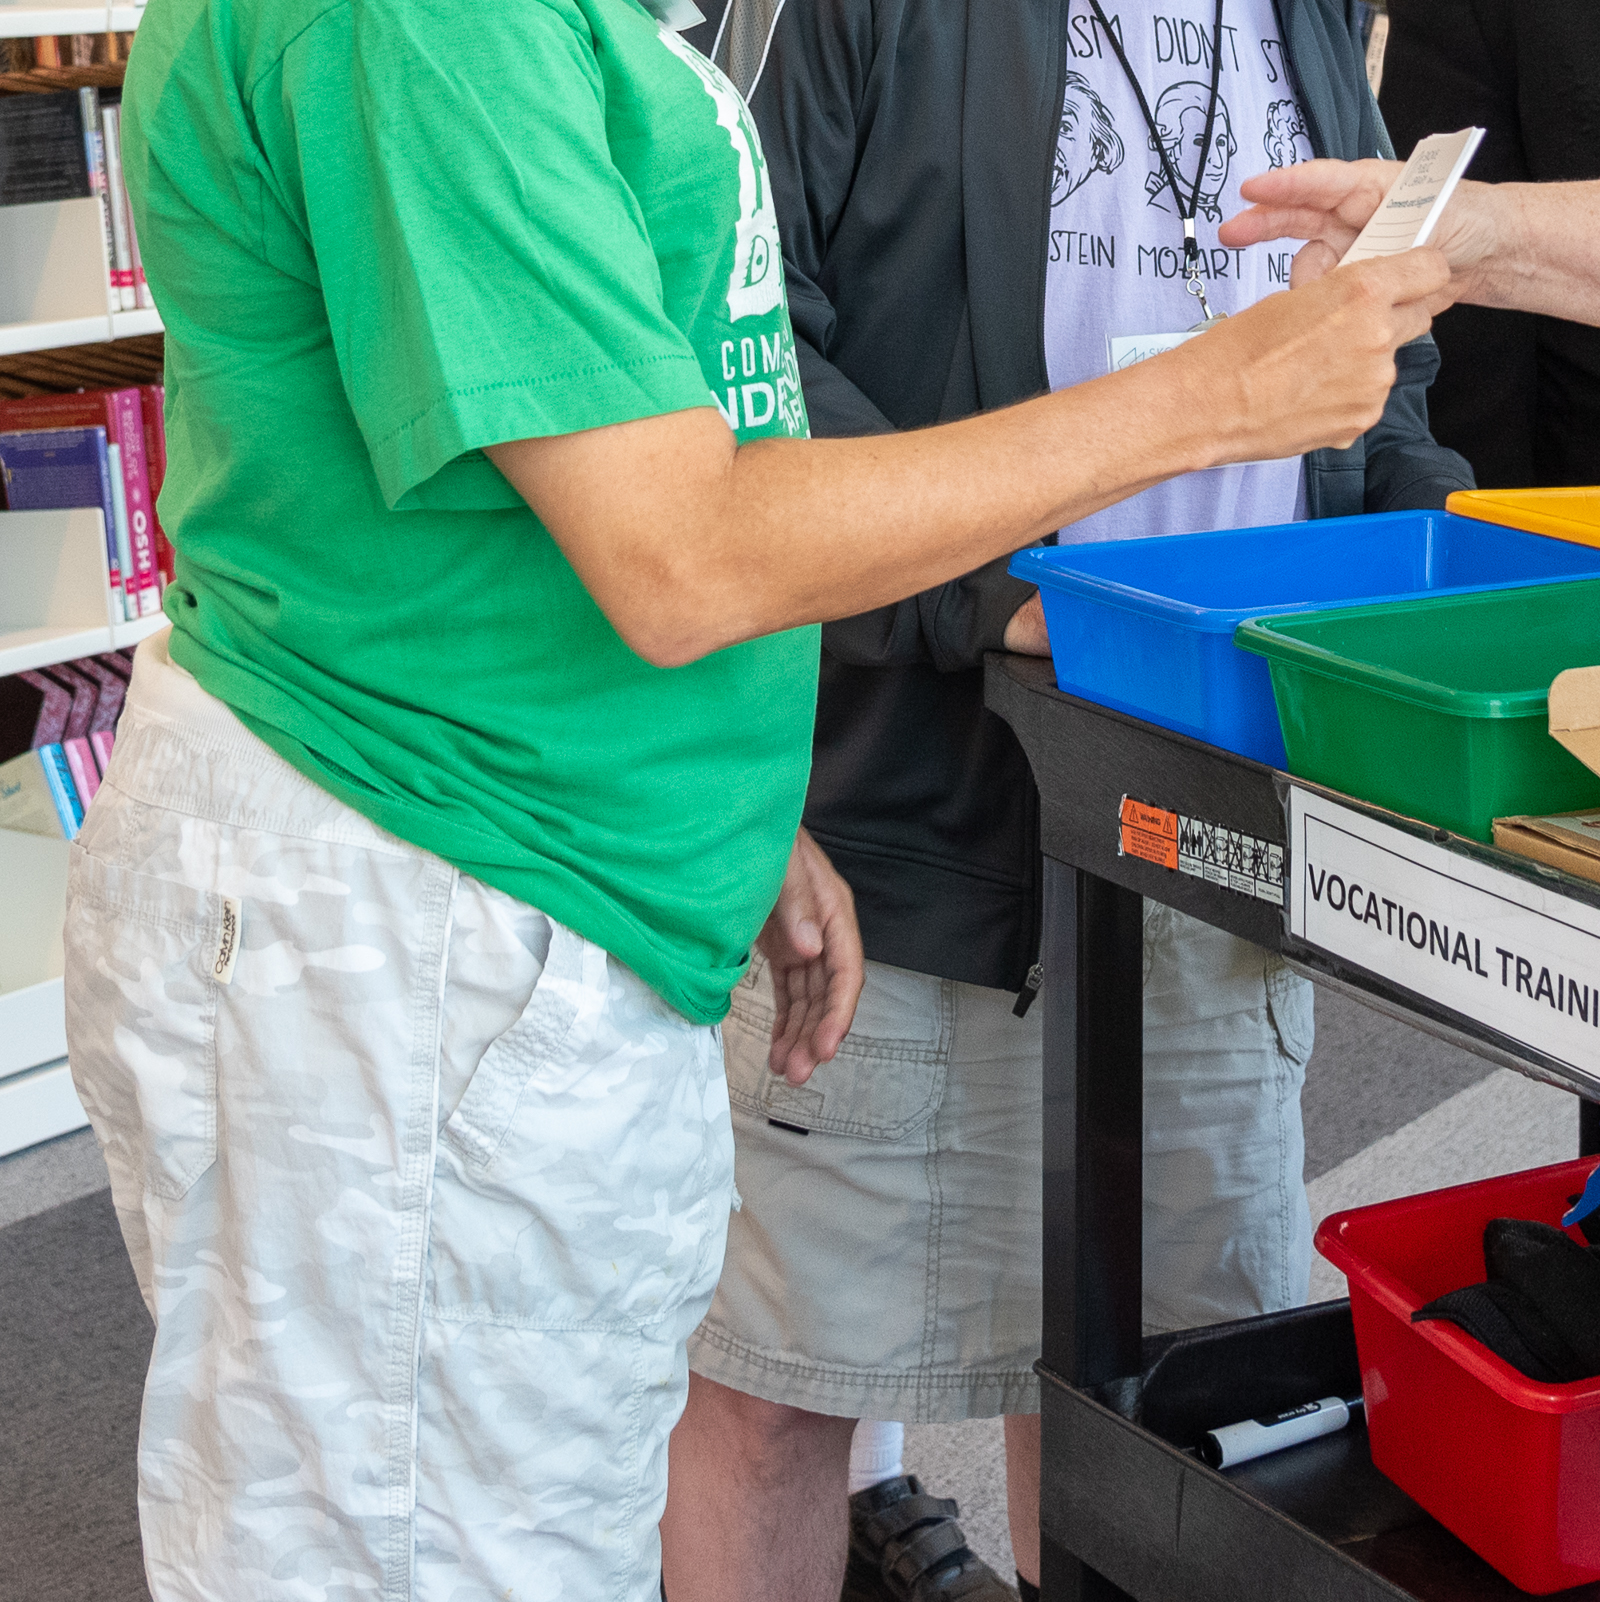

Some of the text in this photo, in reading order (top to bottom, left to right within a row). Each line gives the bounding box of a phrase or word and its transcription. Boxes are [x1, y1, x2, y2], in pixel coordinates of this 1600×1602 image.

[1050, 230, 1115, 268] STEIN
[1268, 252, 1294, 284] NE
[721, 332, 780, 381] COM
[1307, 862, 1489, 979] VOCATIONAL
